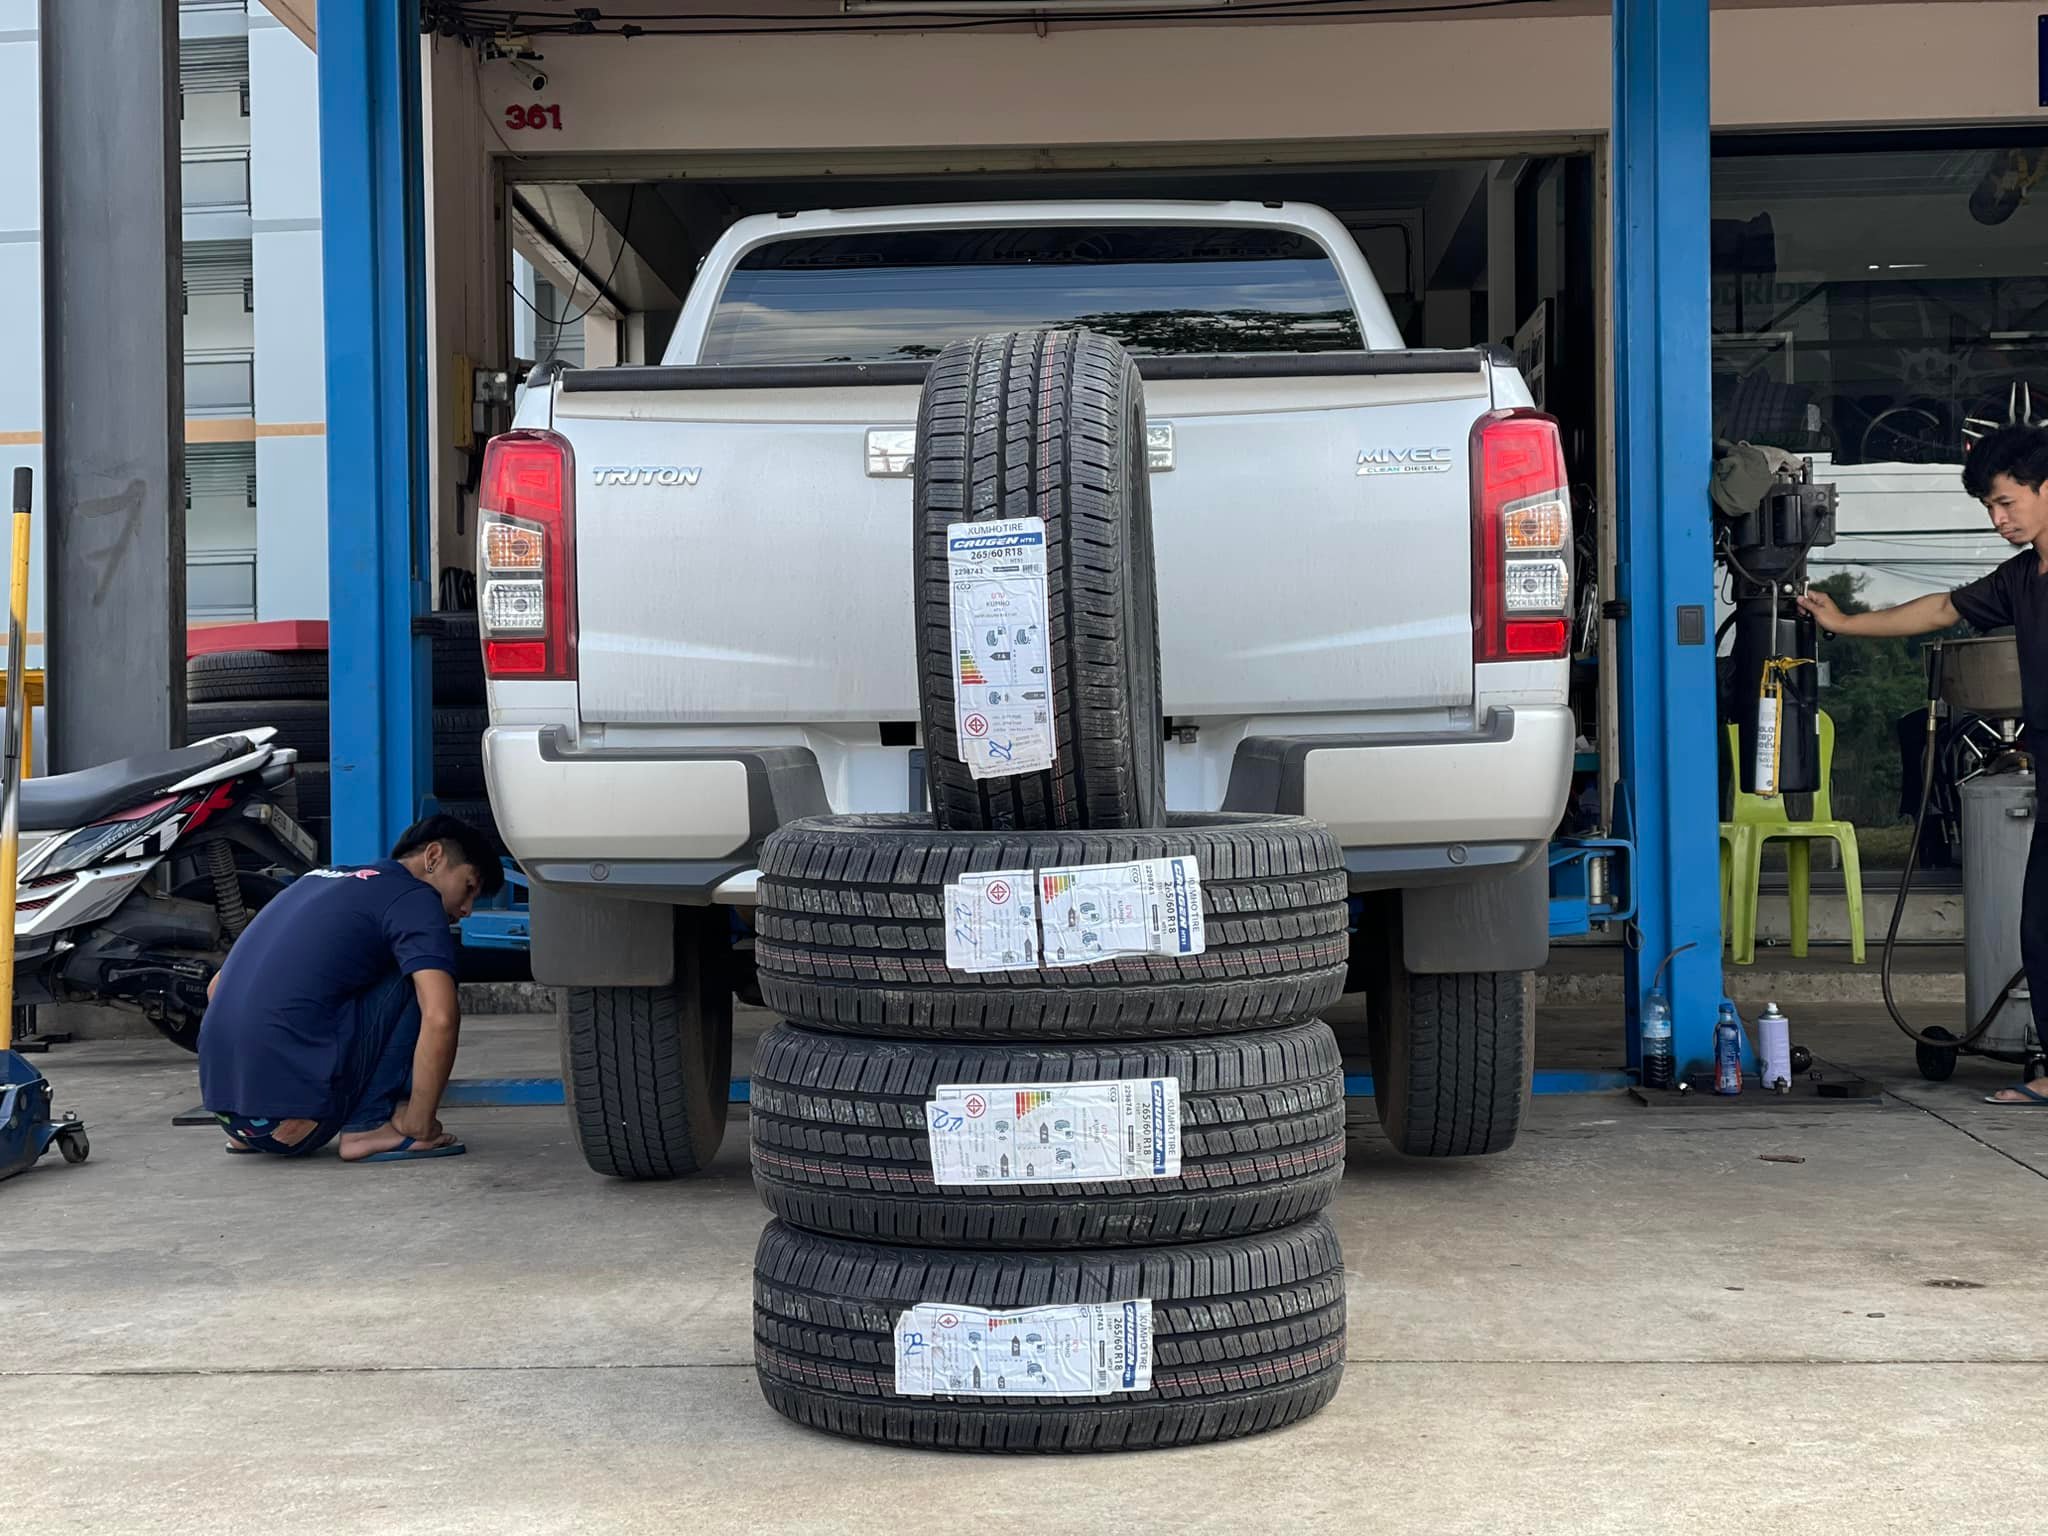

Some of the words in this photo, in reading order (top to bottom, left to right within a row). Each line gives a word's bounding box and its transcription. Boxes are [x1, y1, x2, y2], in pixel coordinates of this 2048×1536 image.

[505, 104, 562, 130] 361
[1357, 448, 1451, 464] MIVEC
[593, 466, 702, 485] TRITON
[1404, 464, 1440, 472] DIESEL
[953, 537, 1019, 548] CRUGEN
[971, 549, 1003, 560] 265/60
[1005, 547, 1023, 557] R18
[1175, 863, 1187, 929] CRUGEN
[1168, 916, 1176, 934] R18
[1142, 1103, 1150, 1135] 265/60
[1154, 1084, 1163, 1152] CRUGEN
[1143, 1137, 1152, 1156] R18
[1114, 1318, 1123, 1350] 265/60
[1126, 1305, 1135, 1365] CRUGEN
[1114, 1353, 1123, 1371] R18
